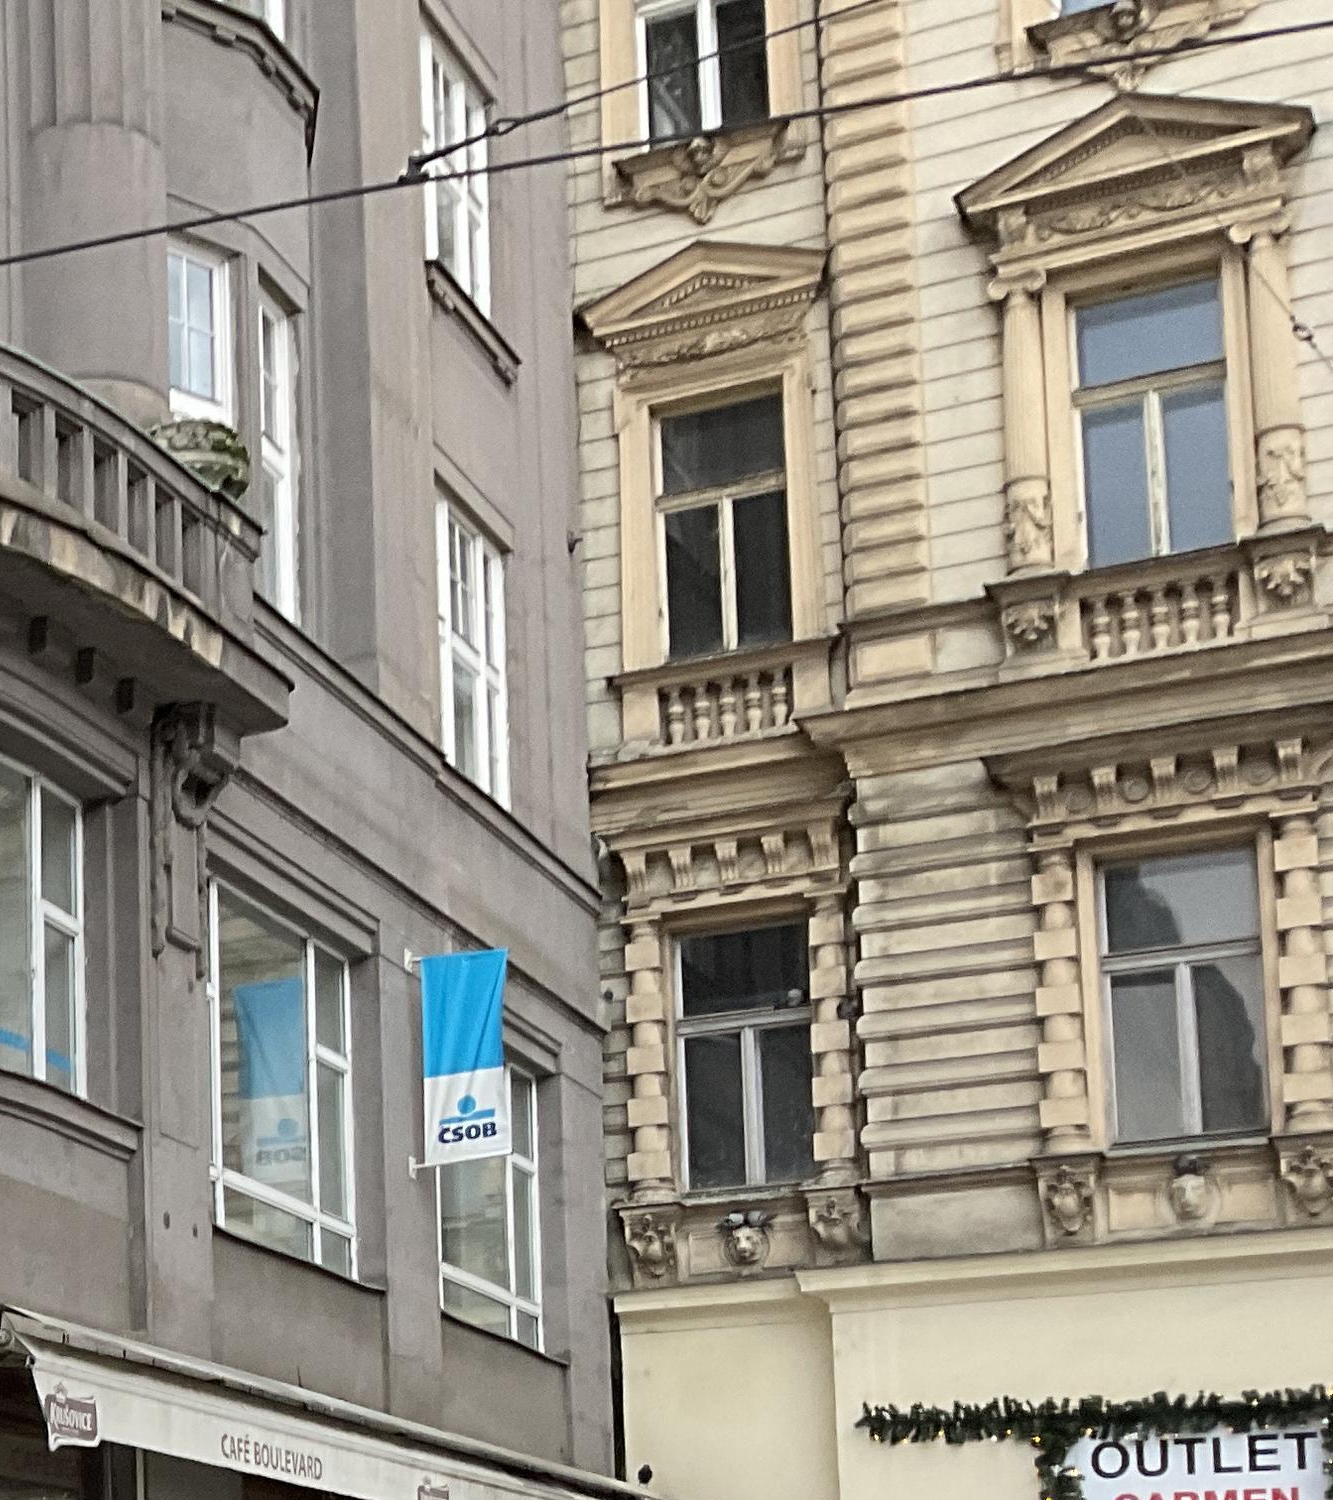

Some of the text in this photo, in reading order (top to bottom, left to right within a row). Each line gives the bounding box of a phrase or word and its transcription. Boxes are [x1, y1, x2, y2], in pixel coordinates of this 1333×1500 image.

[221, 1433, 322, 1480] CAFÉ BOULEVARD
[1091, 1431, 1318, 1479] OUTLET
